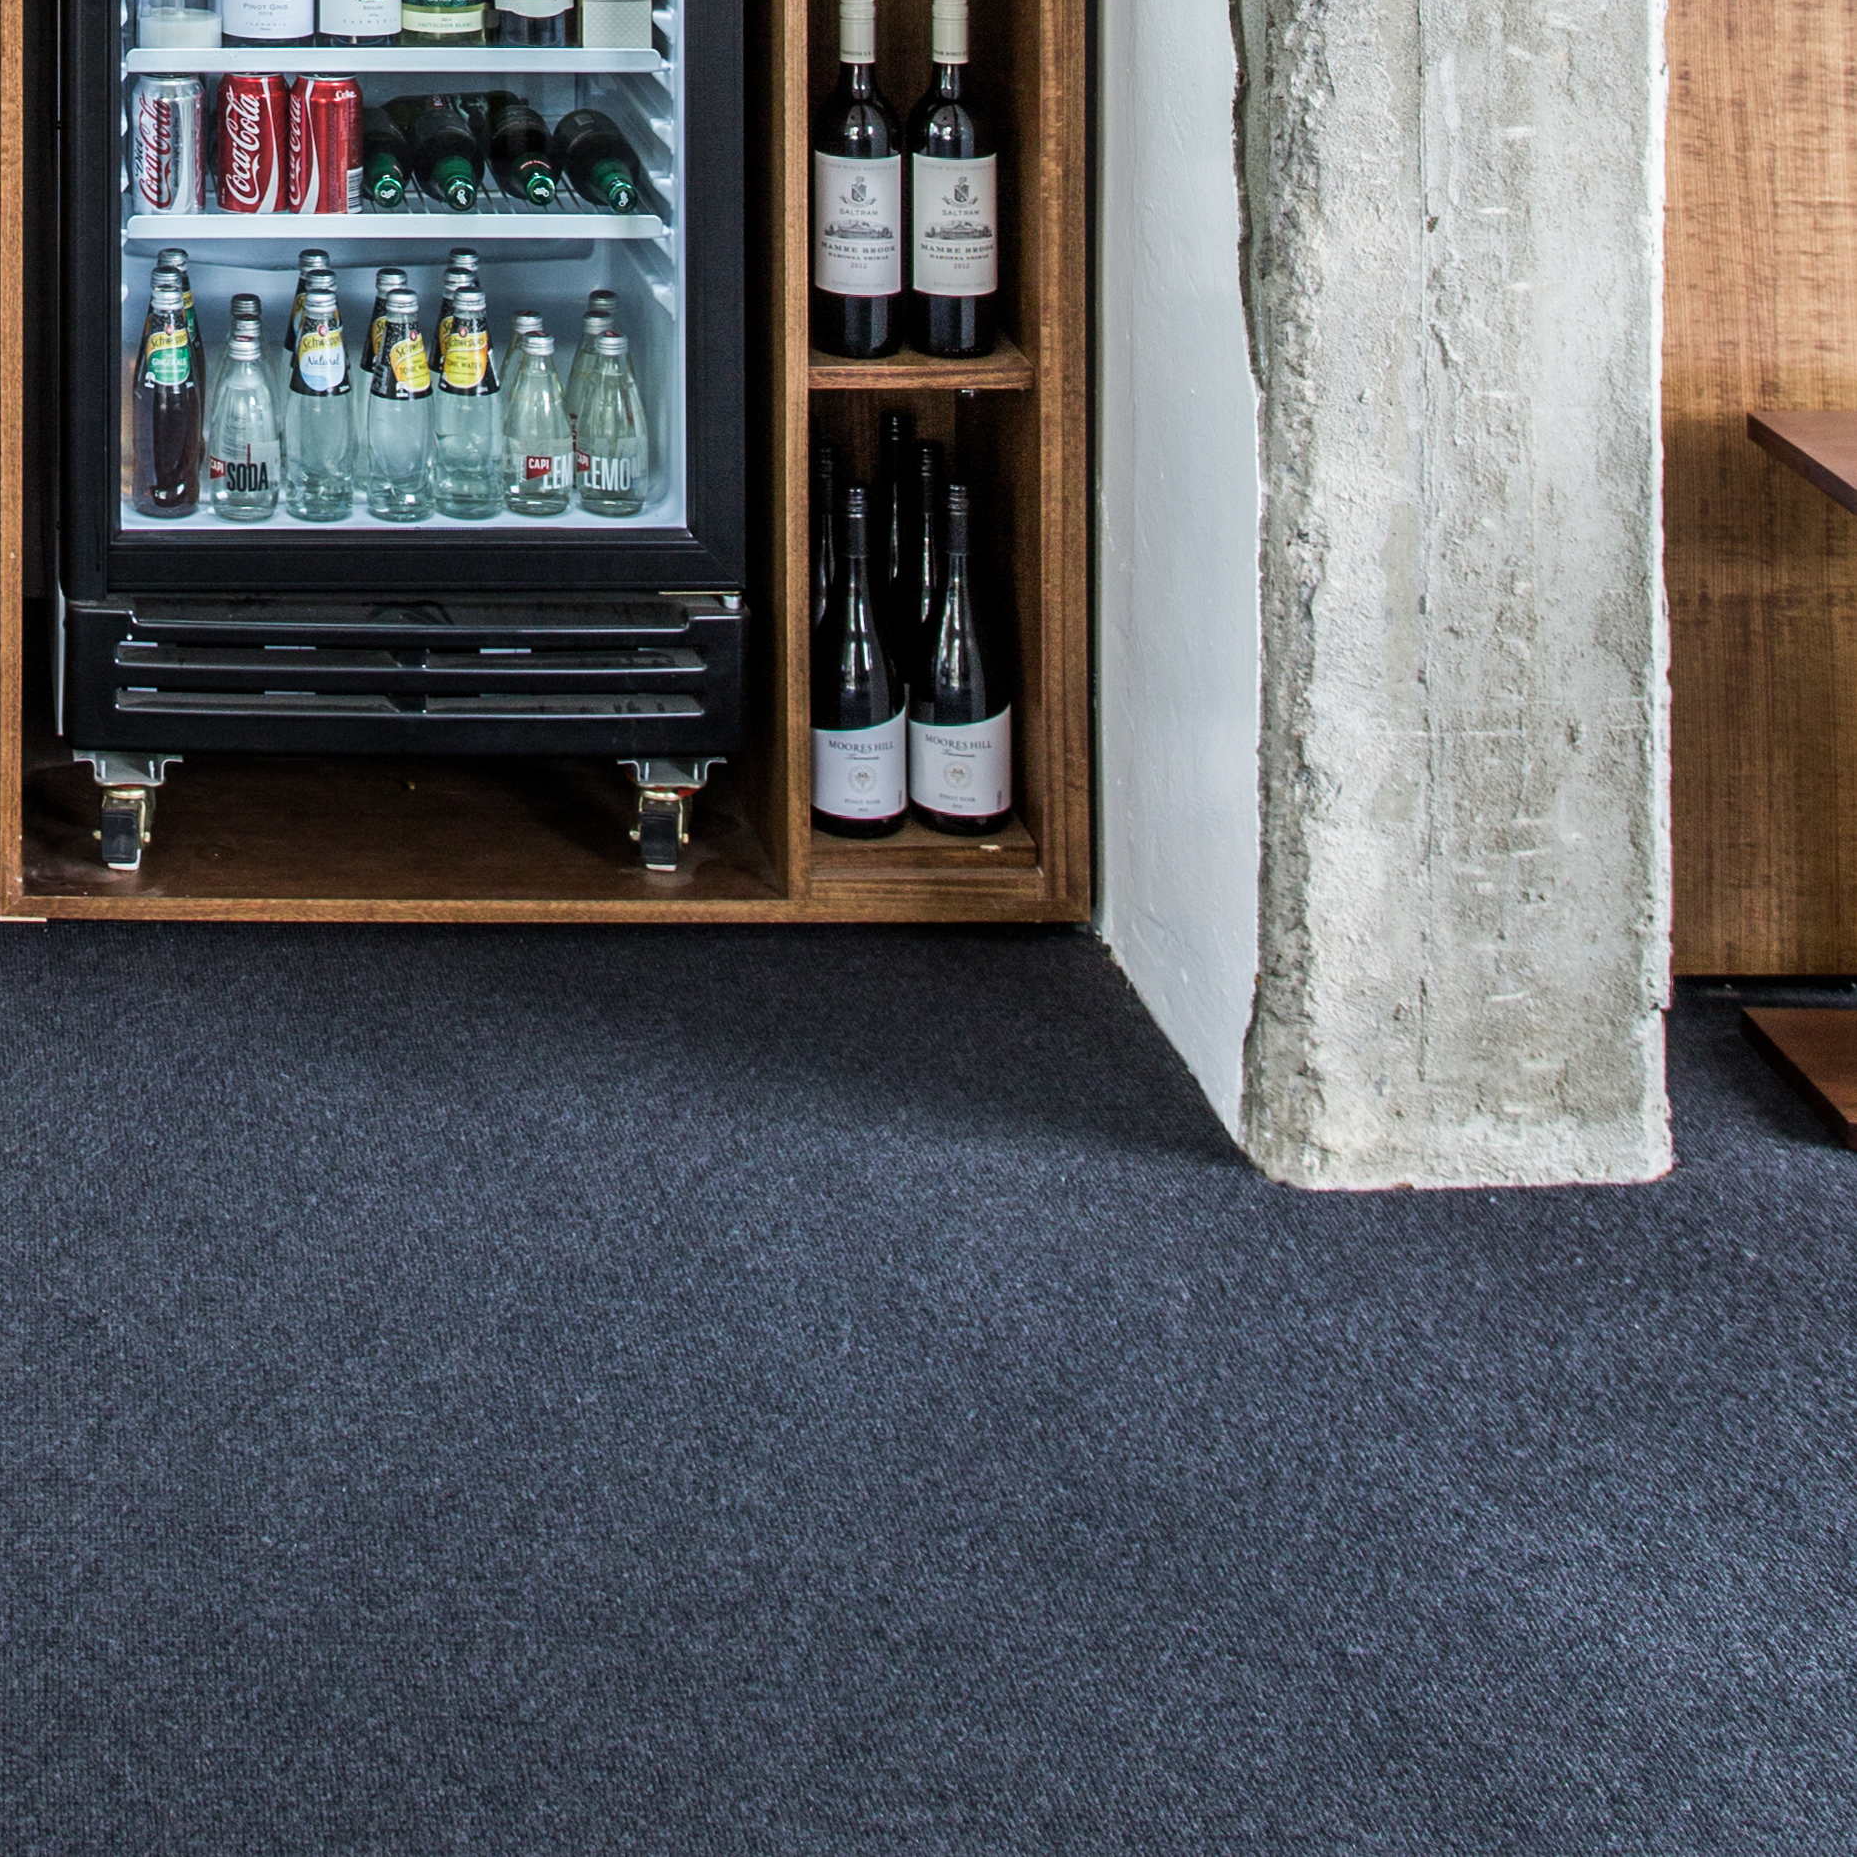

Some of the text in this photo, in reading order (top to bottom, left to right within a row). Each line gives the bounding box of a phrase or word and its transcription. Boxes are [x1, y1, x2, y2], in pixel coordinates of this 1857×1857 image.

[269, 3, 288, 11] GRIS
[335, 89, 357, 102] Coke
[839, 208, 878, 217] SALTRAM
[821, 241, 895, 254] MAMRE BROOK
[921, 243, 994, 254] MAMRE BROOK
[528, 458, 550, 470] CAPI
[227, 461, 269, 492] SODA
[829, 740, 894, 753] MOORES HILL
[926, 735, 992, 750] MOORES HILL
